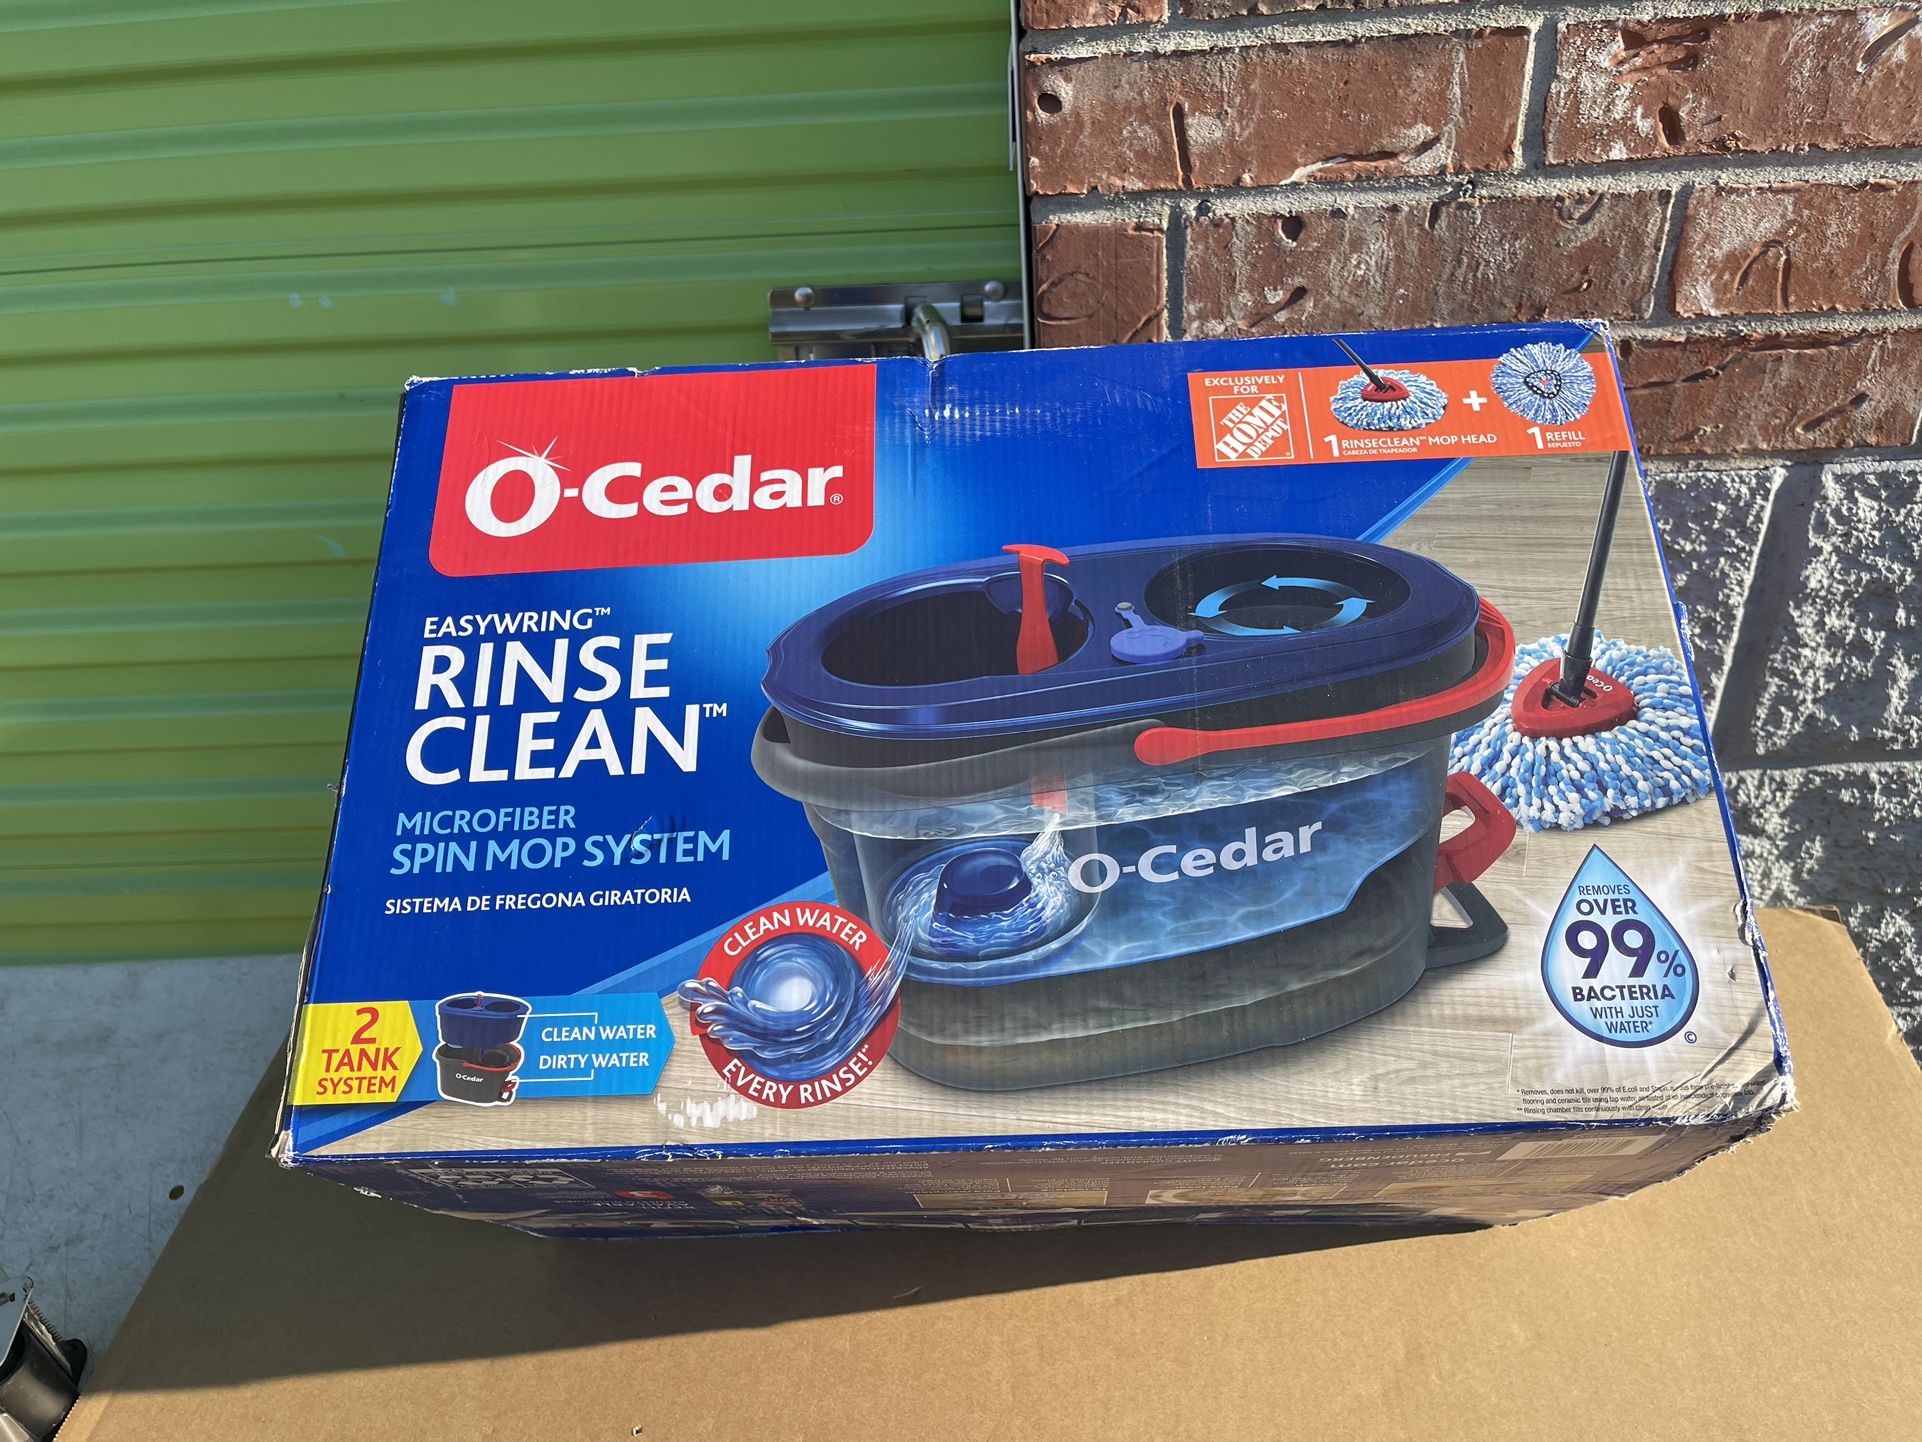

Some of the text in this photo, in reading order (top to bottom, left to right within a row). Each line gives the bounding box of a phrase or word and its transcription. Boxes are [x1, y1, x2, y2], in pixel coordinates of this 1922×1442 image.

[1204, 375, 1285, 386] EXCLUSIVELY
[1233, 385, 1259, 394] FOR
[1220, 401, 1251, 428] THE
[1216, 395, 1286, 460] HOME
[1245, 417, 1288, 460] DEPOT
[1526, 426, 1586, 450] 1 REFILL
[1323, 434, 1340, 457] 1
[1428, 434, 1458, 446] MOP
[1461, 433, 1497, 444] HEAD
[1342, 448, 1368, 456] CABEZA
[1378, 447, 1418, 455] TRAPEADOR
[1547, 441, 1582, 449] REPUESTO
[414, 632, 673, 710] RINSE
[395, 805, 577, 836] MICROFIBER
[389, 829, 731, 875] SPIN MOP SYSTEM
[1067, 821, 1323, 894] O-Cedar
[384, 887, 692, 915] SISTEMA DE FREGONA GIRATORIA
[1578, 884, 1631, 896] REMOVES
[1575, 898, 1638, 916] OVER
[723, 907, 868, 956] CLEAN WATER
[1564, 918, 1686, 980] 99%
[1571, 984, 1676, 1002] BACTERIA
[1589, 1005, 1660, 1019] WITH JUST
[350, 1006, 380, 1045] 2
[541, 1024, 657, 1042] CLEAN WATER
[322, 1046, 402, 1073] TANK
[538, 1052, 649, 1069] DIRTY WATER
[315, 1075, 398, 1096] SYSTEM
[455, 1073, 484, 1084] O-Cedar
[722, 1057, 794, 1104] EVERY
